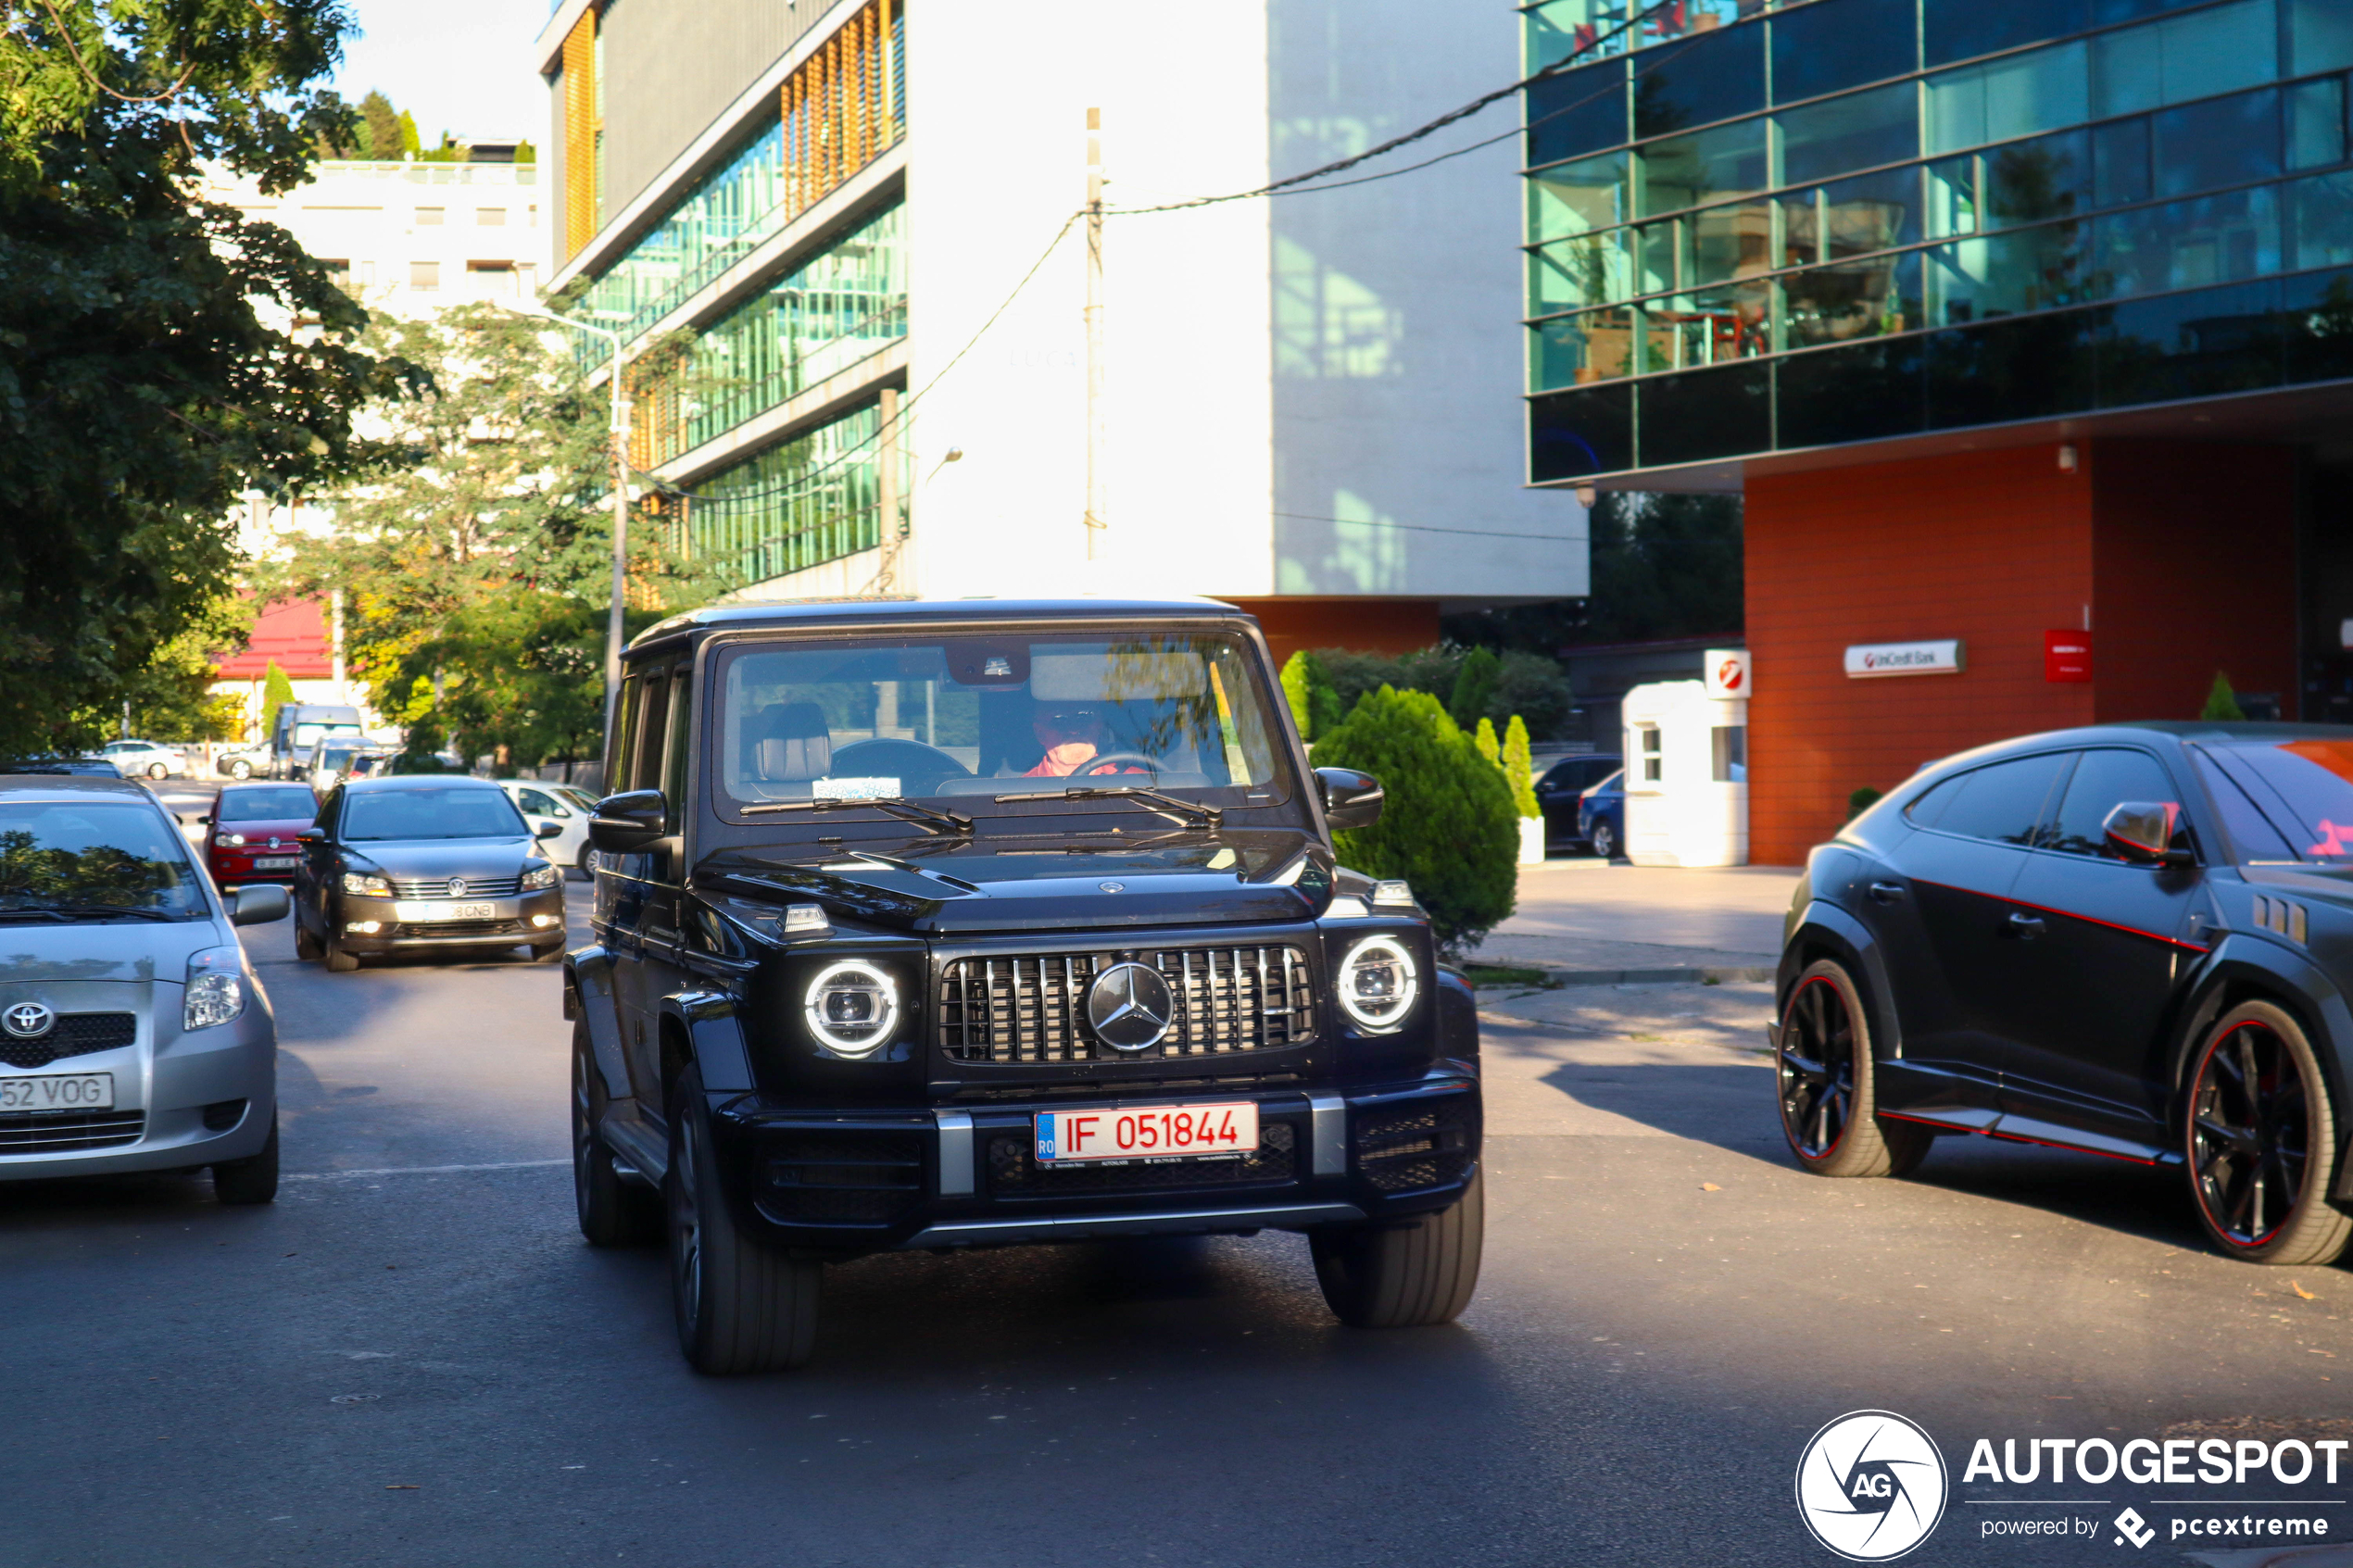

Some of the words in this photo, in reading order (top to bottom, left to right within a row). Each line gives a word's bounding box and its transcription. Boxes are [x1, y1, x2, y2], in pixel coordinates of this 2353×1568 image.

[464, 905, 491, 917] CNB
[2, 1081, 34, 1107] 52
[42, 1079, 101, 1105] VOG
[1066, 1117, 1100, 1152] IF
[1116, 1110, 1238, 1149] 051844
[1038, 1140, 1054, 1154] RO
